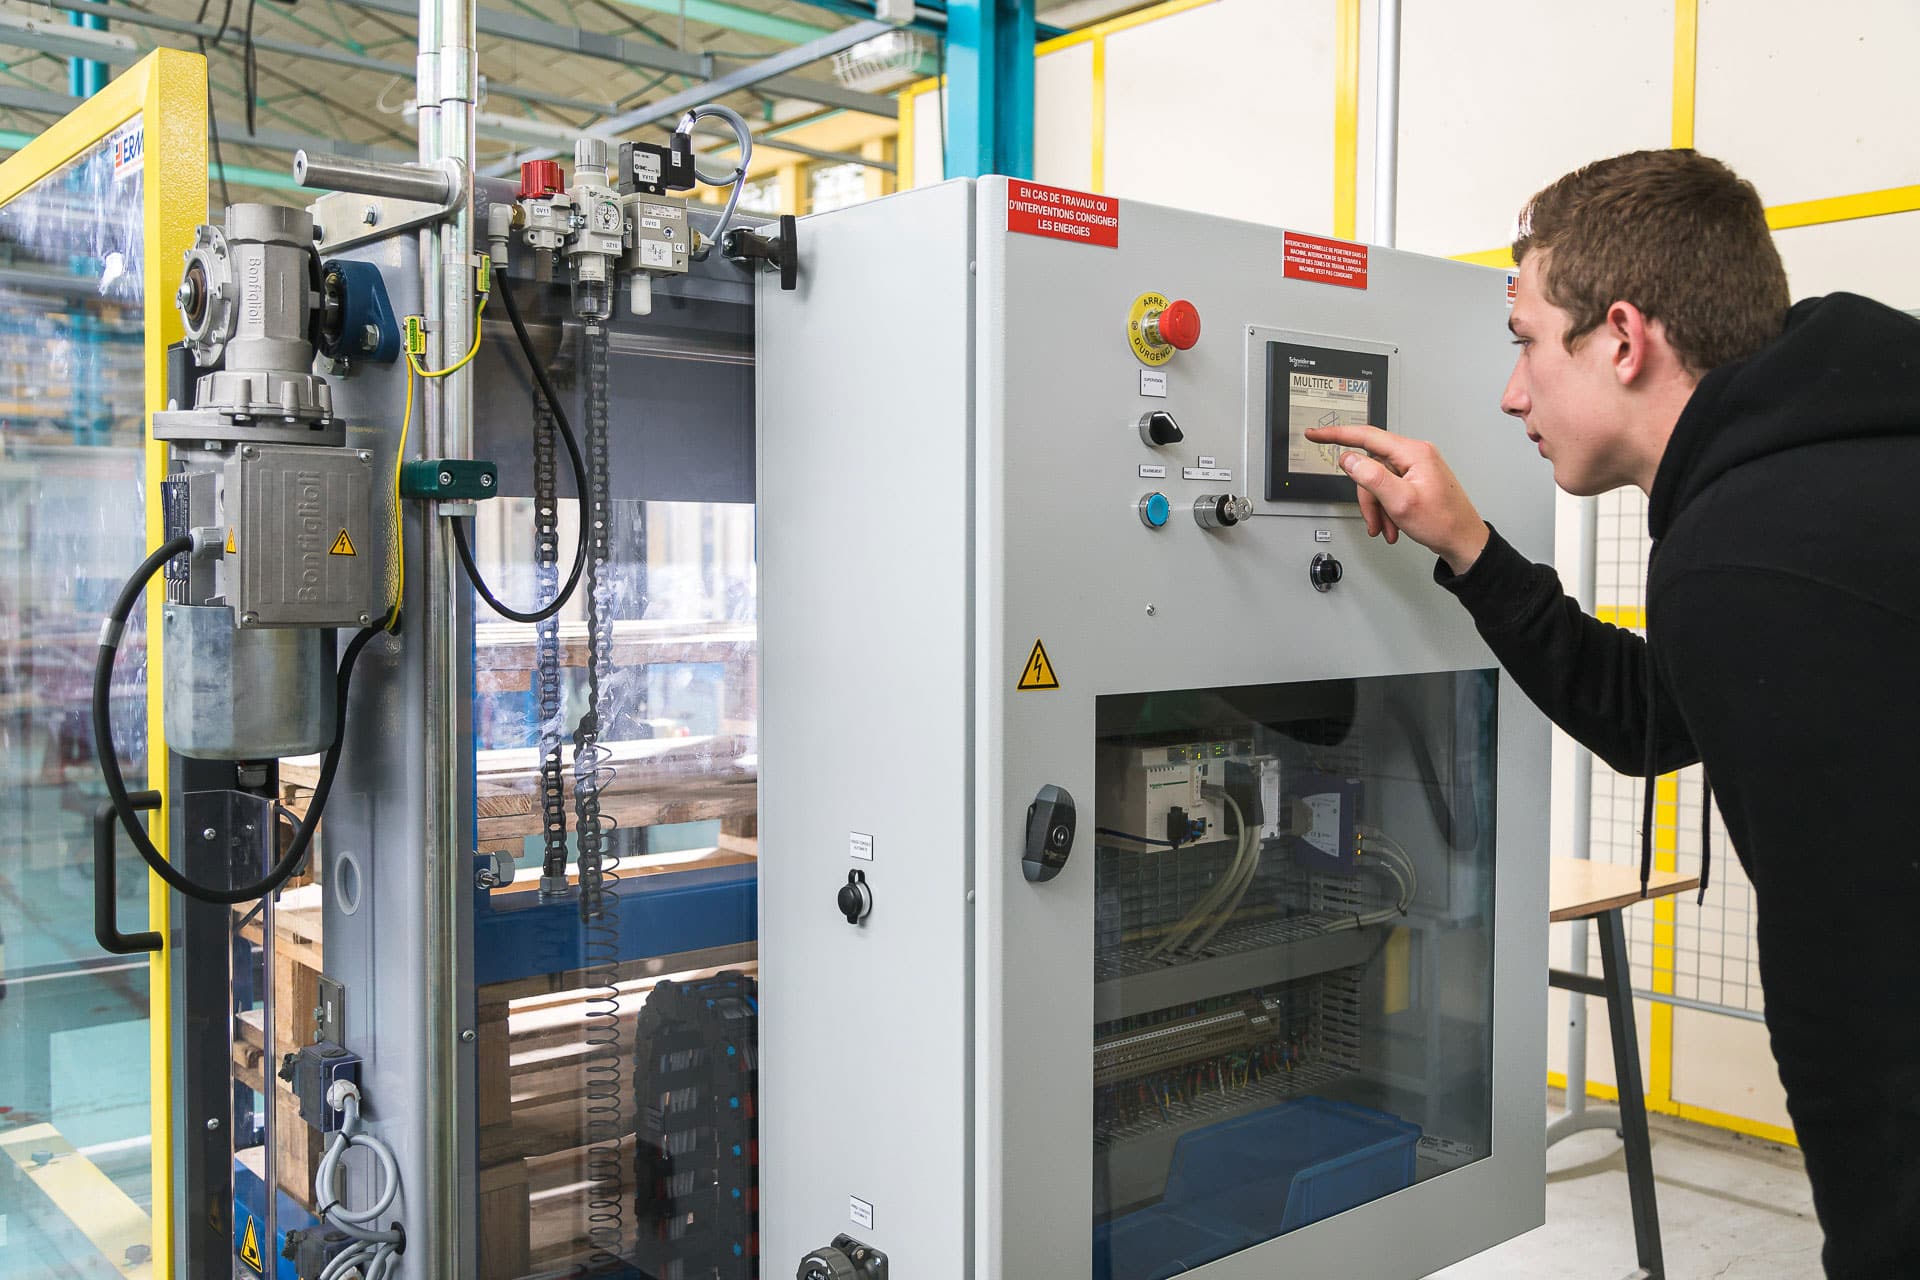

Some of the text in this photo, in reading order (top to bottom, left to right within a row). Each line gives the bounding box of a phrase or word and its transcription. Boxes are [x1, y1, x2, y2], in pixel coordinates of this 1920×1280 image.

[1020, 187, 1107, 211] EN CAS DE TRAVAUX OU
[1009, 200, 1117, 227] D'INTERVENTIONS CONSIGNER
[1038, 219, 1090, 236] LES ENERGIES
[247, 258, 262, 324] Bonfiglioli
[1134, 338, 1173, 360] D'URGENC
[1294, 376, 1334, 389] MULTITEC
[1348, 380, 1368, 394] ERM
[298, 470, 321, 601] Bonfiglioli
